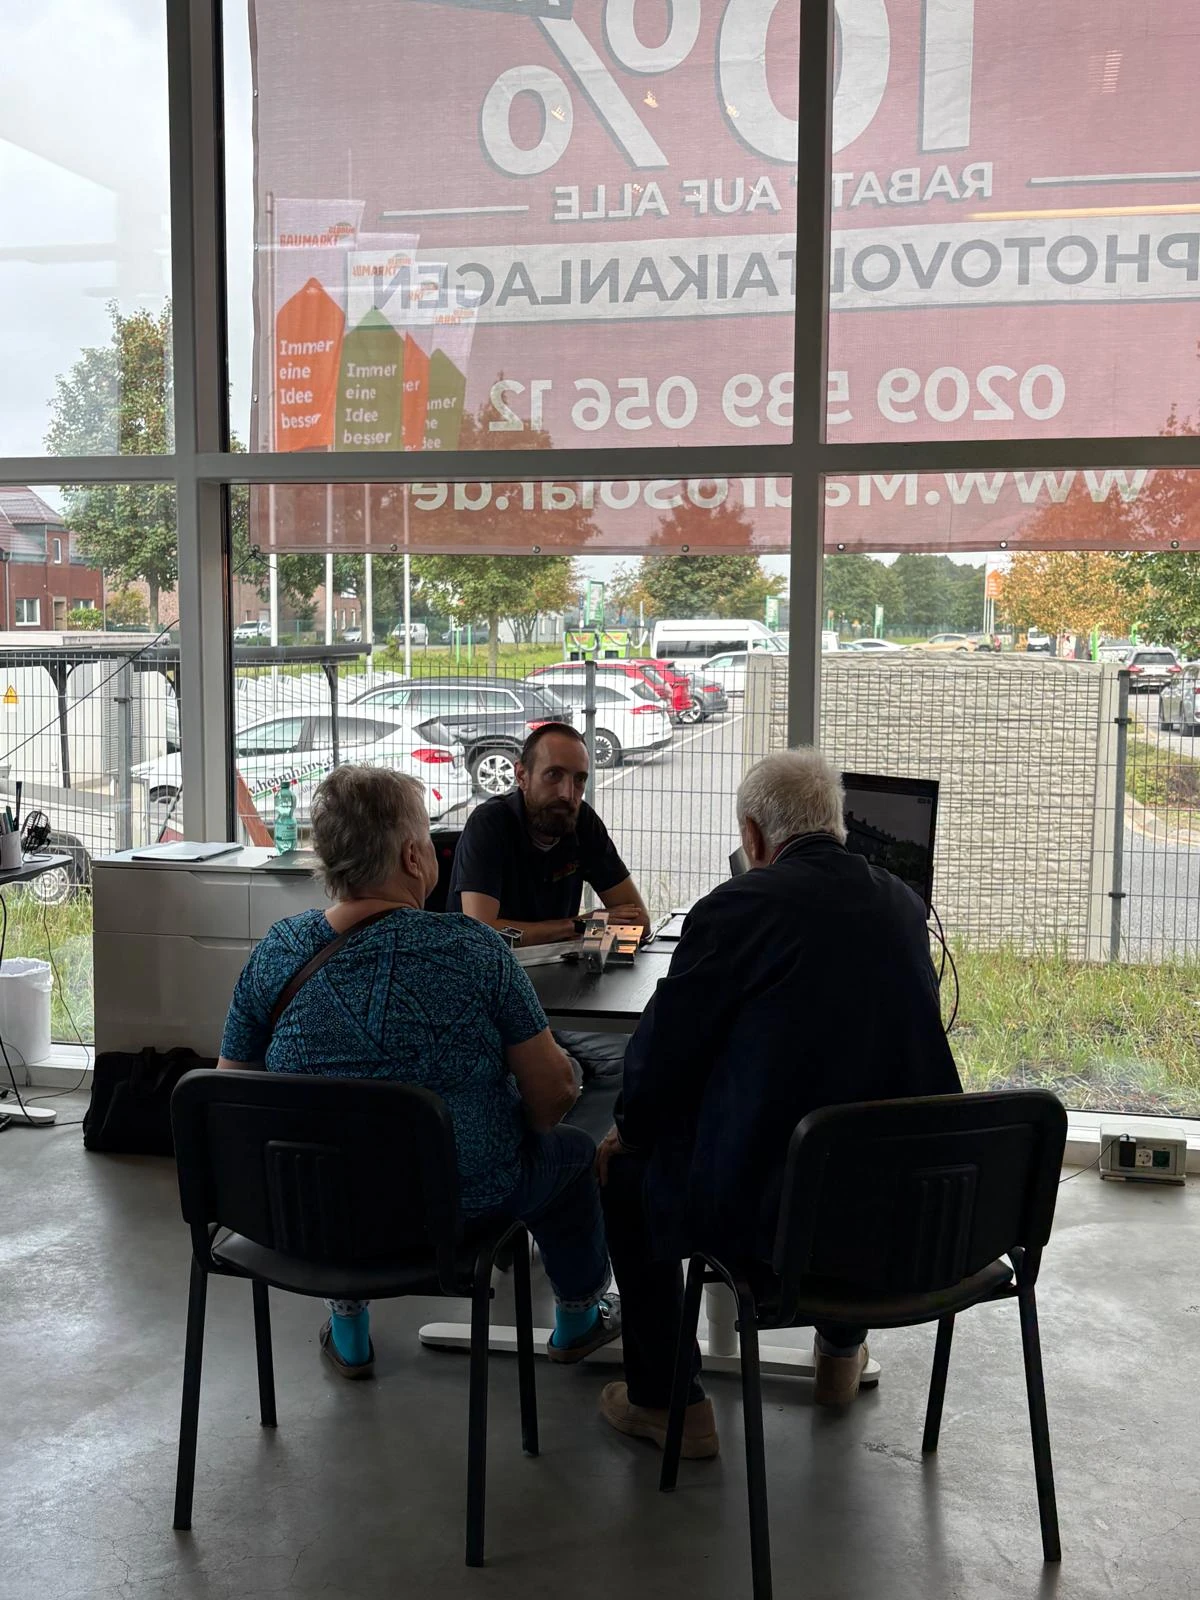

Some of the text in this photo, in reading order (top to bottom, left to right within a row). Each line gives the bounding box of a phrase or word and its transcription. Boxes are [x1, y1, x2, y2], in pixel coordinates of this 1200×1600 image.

[279, 339, 335, 356] Immer
[279, 362, 312, 380] eine
[347, 362, 397, 378] Immer
[279, 387, 313, 405] Idee
[345, 384, 376, 400] eine
[344, 408, 379, 422] Idee
[343, 429, 393, 445] besser
